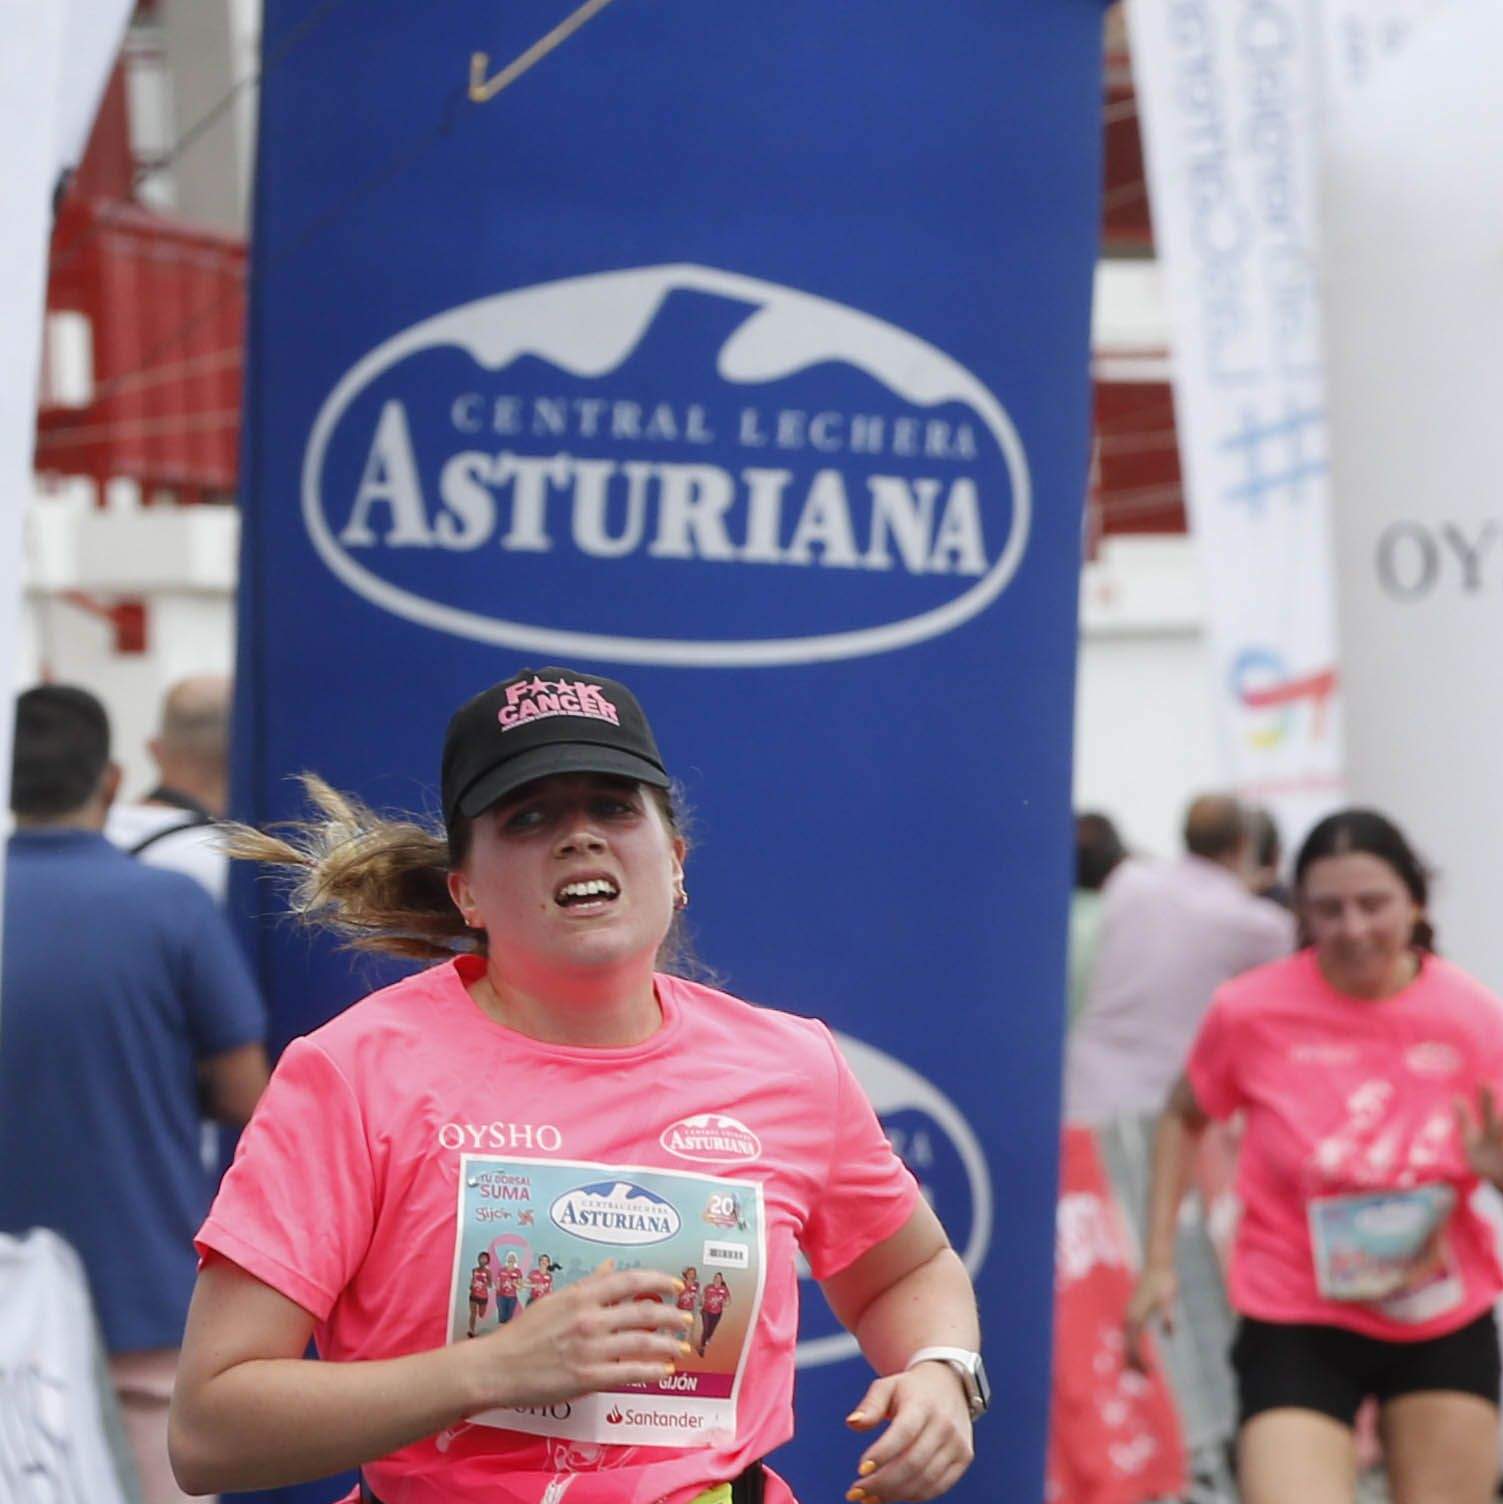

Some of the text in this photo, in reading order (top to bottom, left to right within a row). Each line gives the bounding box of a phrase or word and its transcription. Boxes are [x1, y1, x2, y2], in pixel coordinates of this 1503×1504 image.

[451, 392, 977, 459] CENTRAL LECHERA
[340, 399, 990, 575] ASTURIANA
[498, 694, 619, 725] CANCER
[438, 1122, 563, 1151] OYSHO
[671, 1130, 755, 1155] ASTURIANA
[479, 1184, 530, 1201] SUMA
[709, 1194, 734, 1216] 20
[560, 1200, 671, 1234] ASTURIANA
[658, 1372, 699, 1392] GIJÓN
[625, 1409, 704, 1429] Santander
